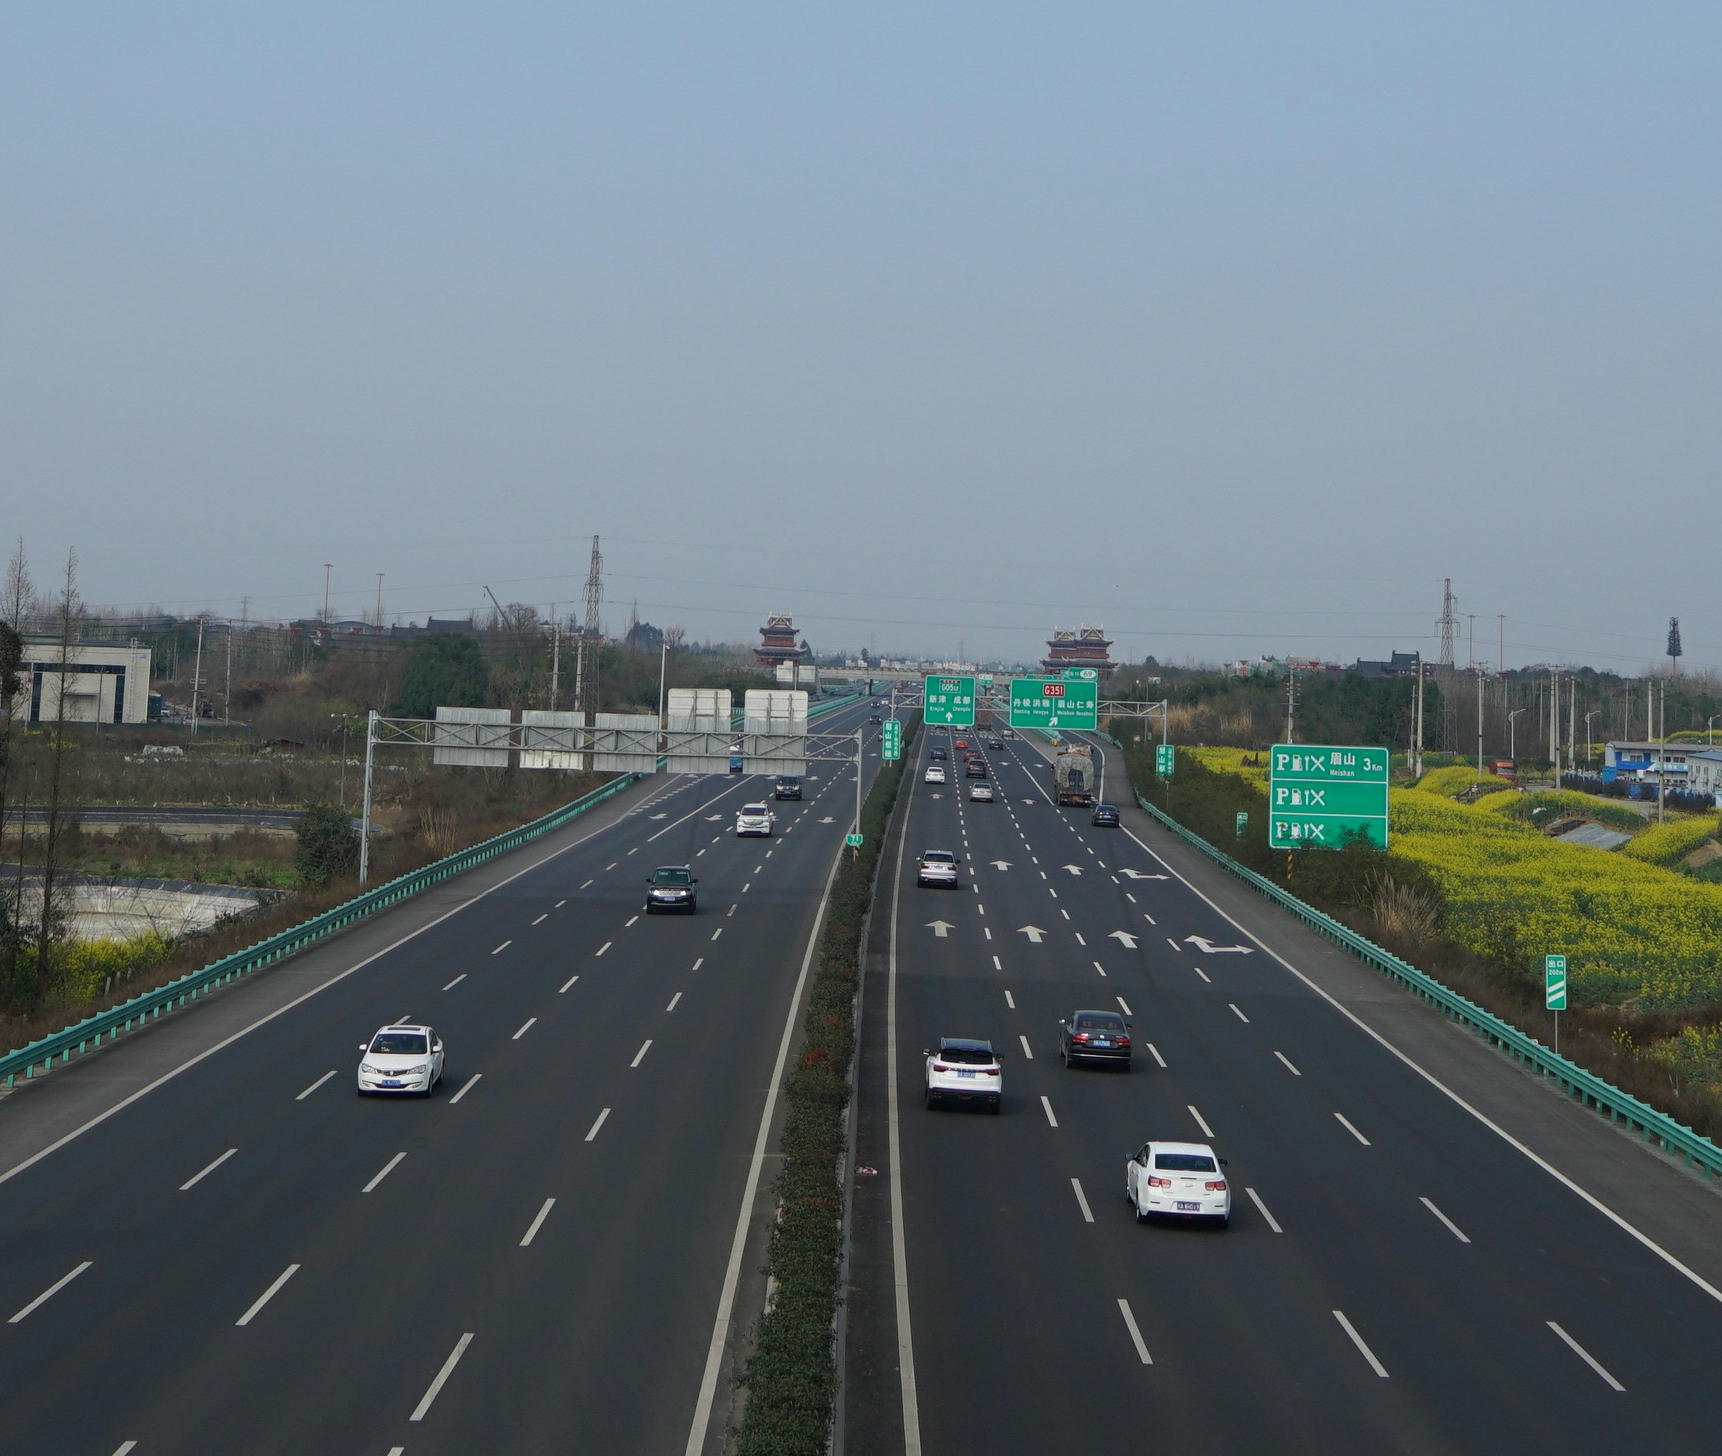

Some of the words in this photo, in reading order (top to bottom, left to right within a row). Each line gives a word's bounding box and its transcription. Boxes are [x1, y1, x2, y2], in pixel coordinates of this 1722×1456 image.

[1044, 685, 1064, 695] G351
[1330, 752, 1356, 766] 眉山
[1329, 769, 1355, 777] Meishan
[1548, 959, 1564, 968] 出口
